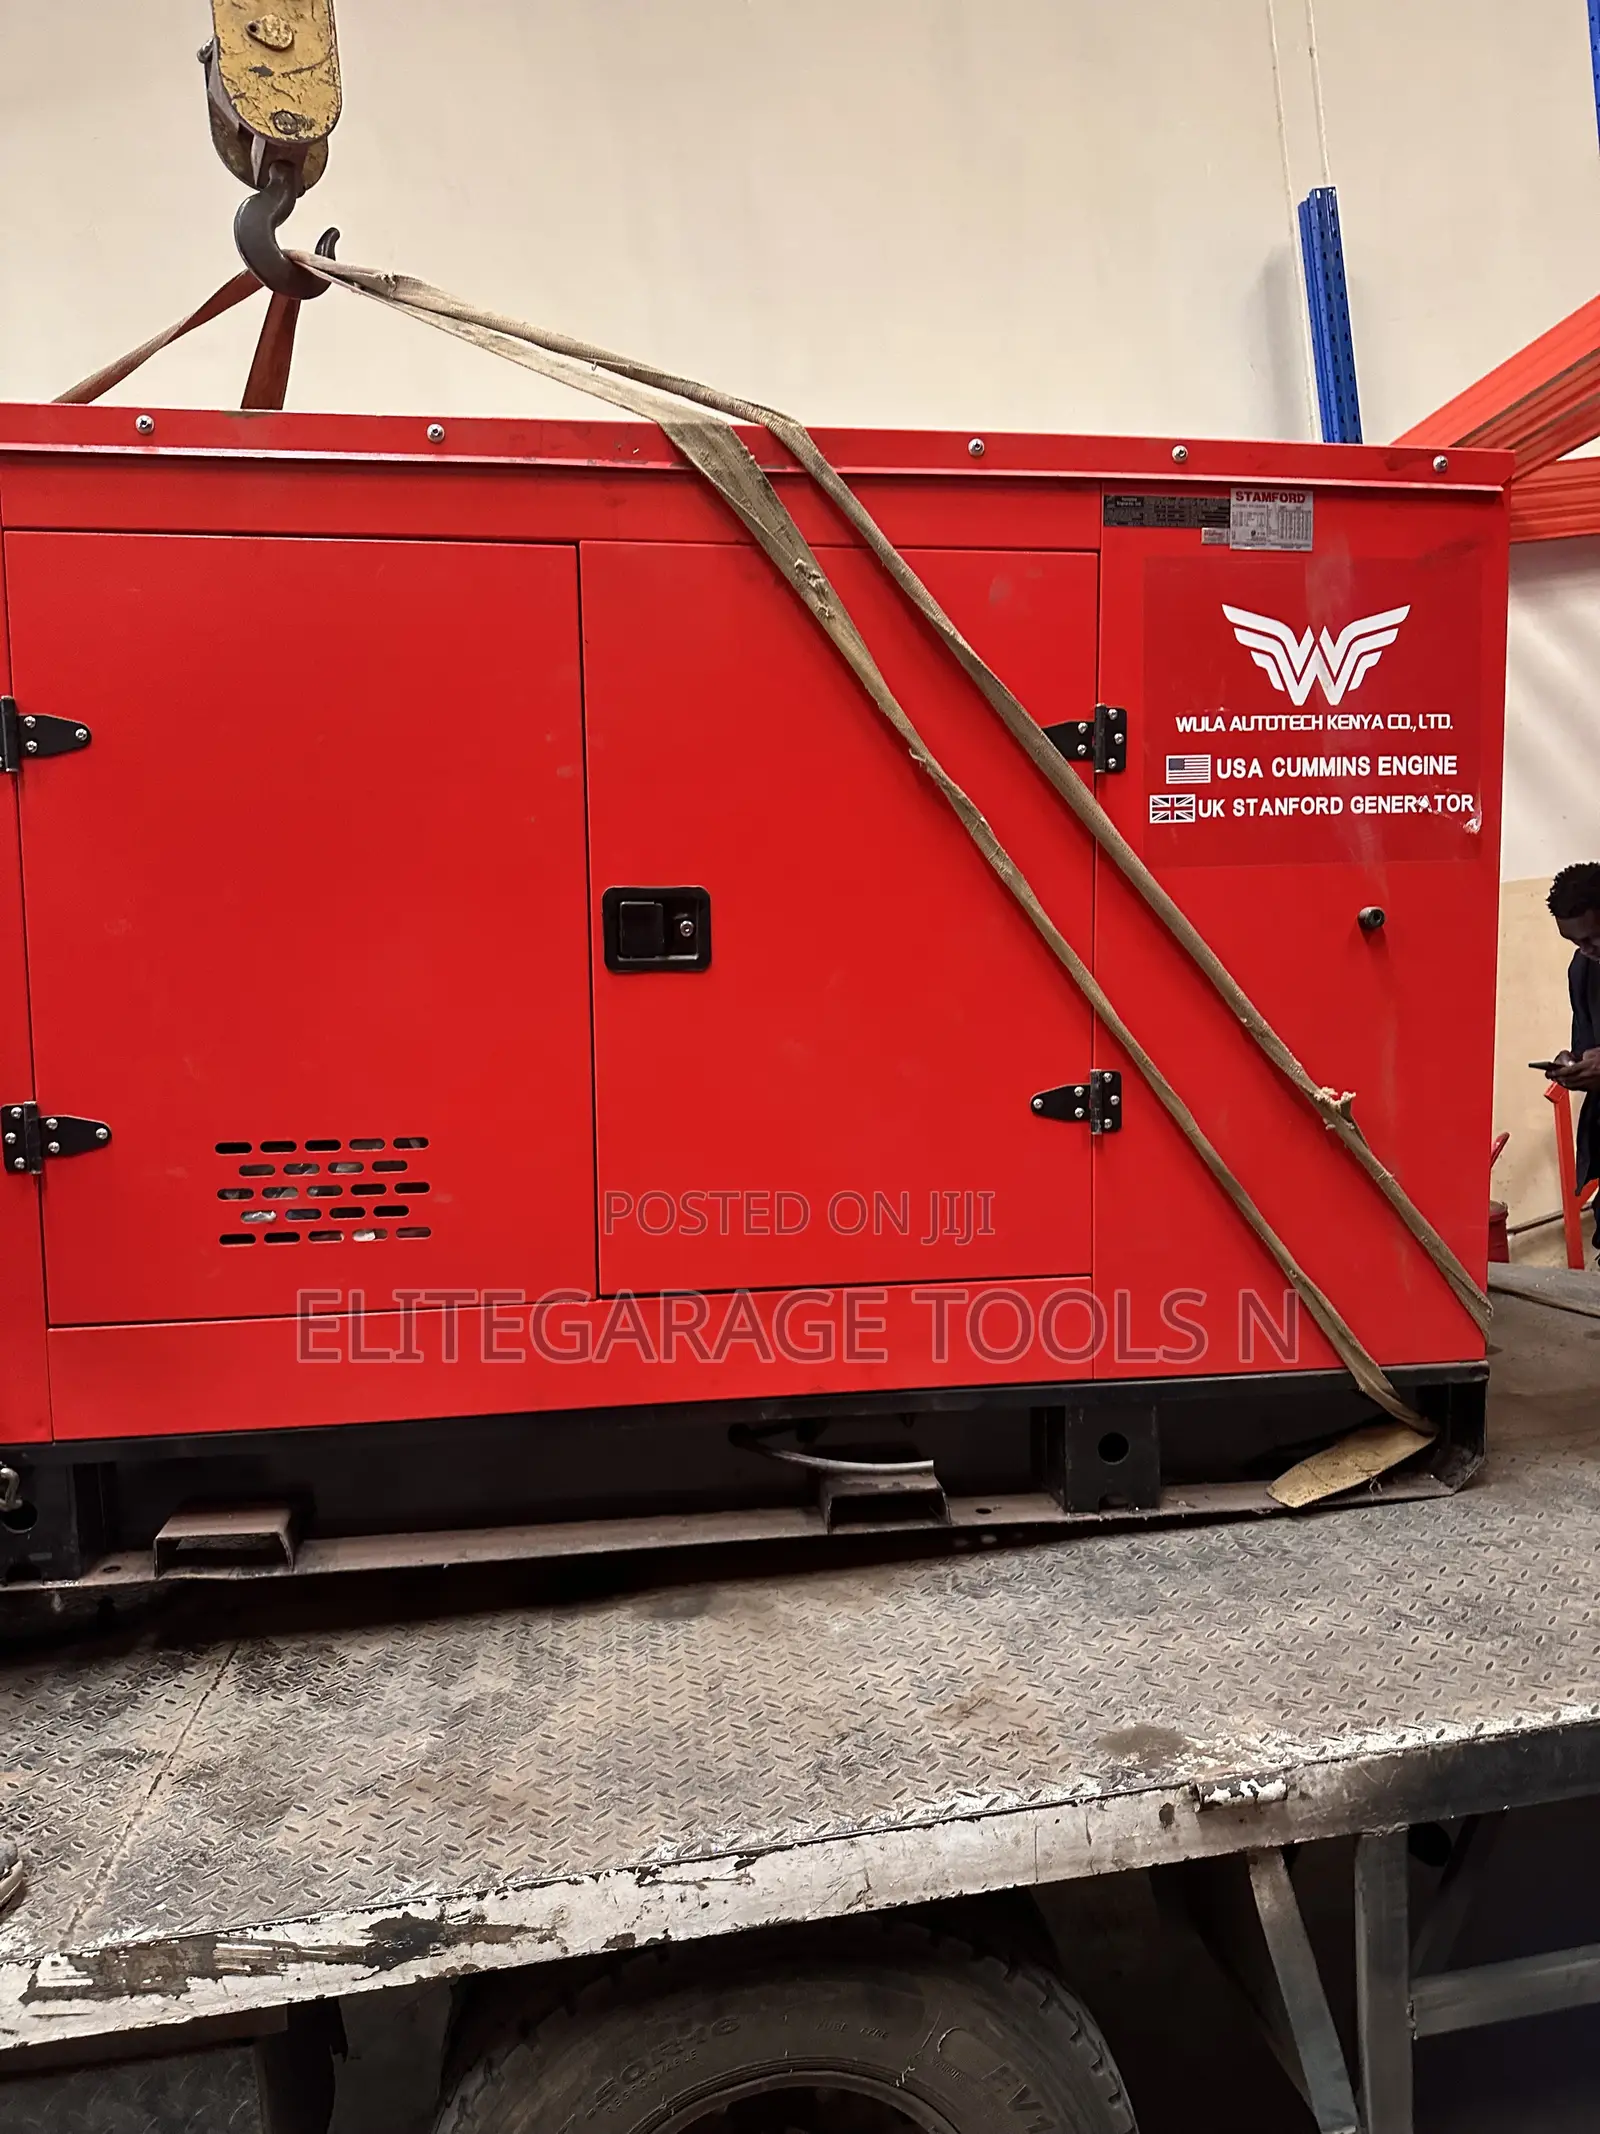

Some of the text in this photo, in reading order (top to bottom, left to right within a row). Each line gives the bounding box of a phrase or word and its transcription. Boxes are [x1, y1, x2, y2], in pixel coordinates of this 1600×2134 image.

[1235, 490, 1306, 504] STAMFORD
[1175, 715, 1226, 733] WULA
[1229, 714, 1324, 732] AUTOTECH
[1327, 714, 1385, 730] KENYA
[1216, 754, 1458, 780] USA CUMMINS ENGINE
[1197, 797, 1226, 818] UK
[1232, 795, 1344, 818] STANFORD
